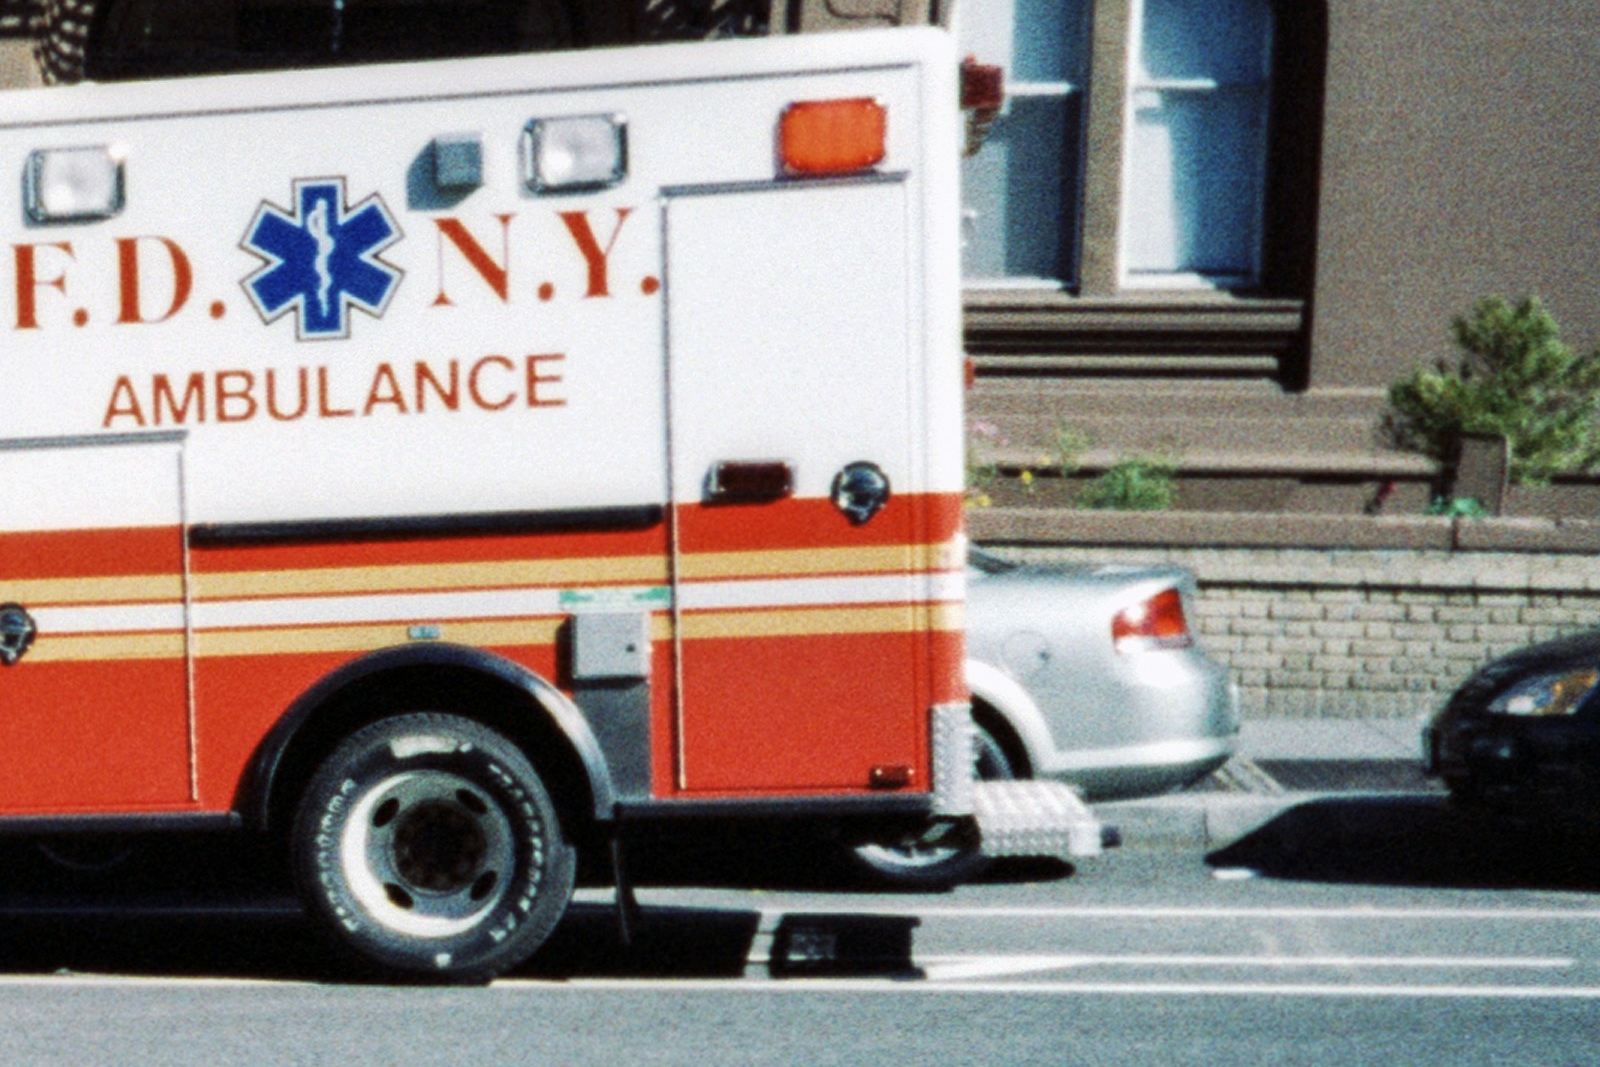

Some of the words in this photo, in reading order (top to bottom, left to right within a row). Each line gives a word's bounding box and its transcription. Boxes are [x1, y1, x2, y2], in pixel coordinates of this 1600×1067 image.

[12, 235, 226, 330] F.D.
[428, 207, 662, 307] N.Y.
[102, 352, 567, 428] AMBULANCE
